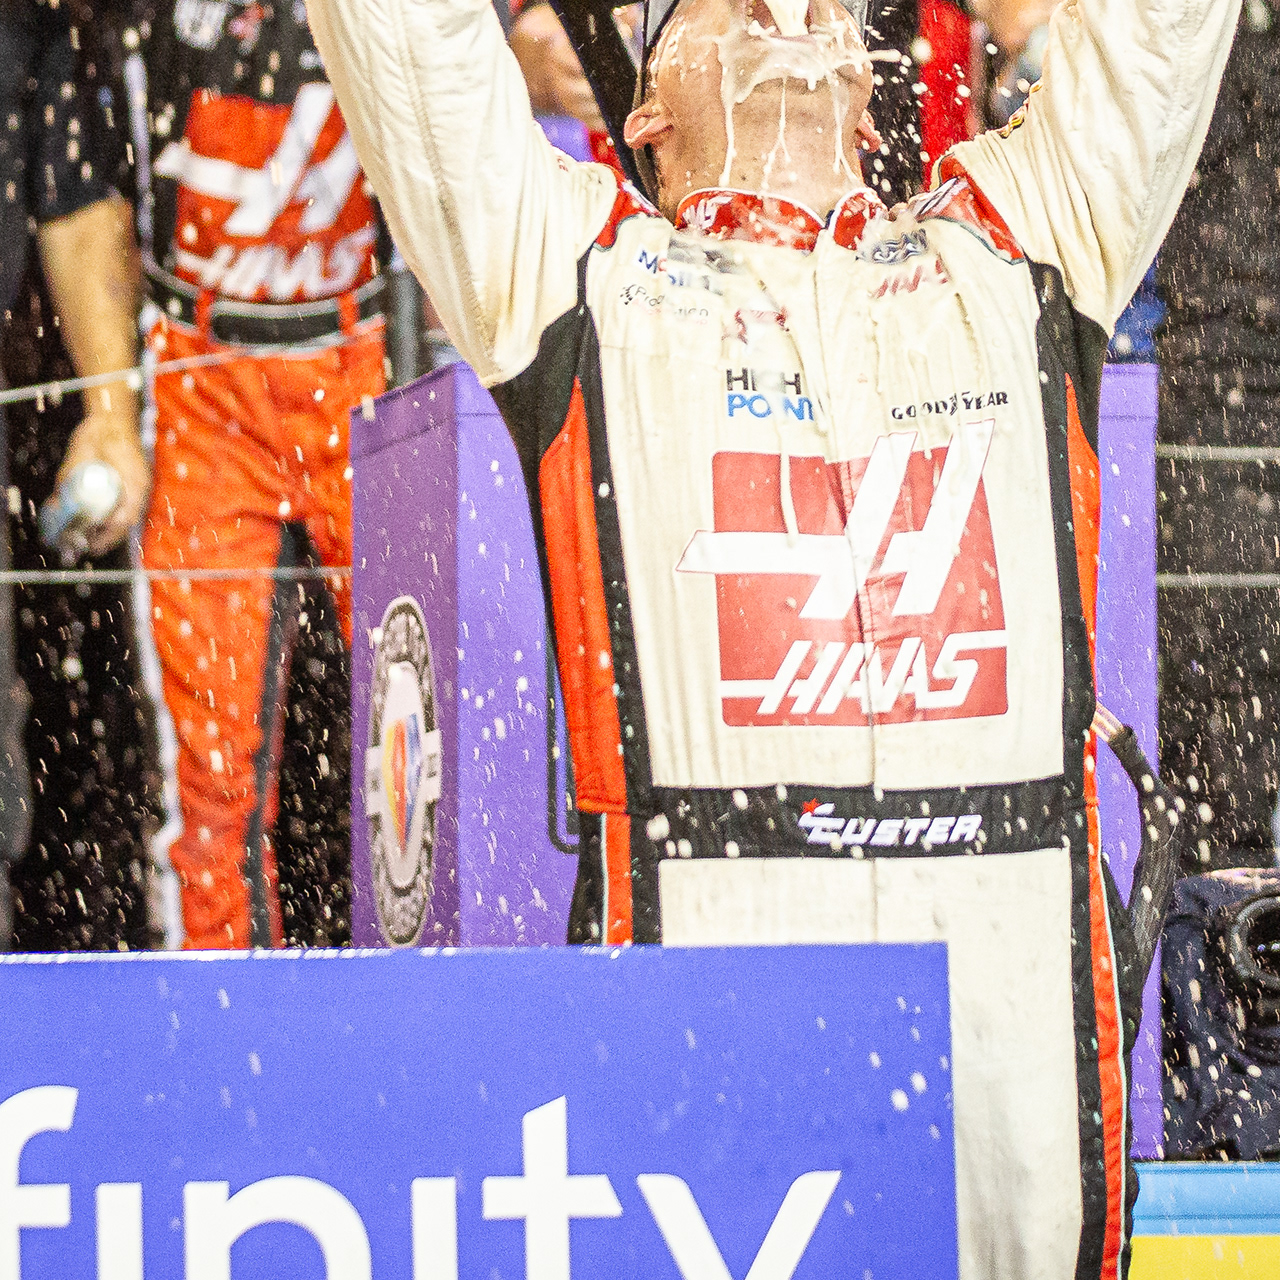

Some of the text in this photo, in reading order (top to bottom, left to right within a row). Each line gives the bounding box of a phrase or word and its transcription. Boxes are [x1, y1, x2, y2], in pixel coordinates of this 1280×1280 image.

[726, 367, 803, 396] HIH
[727, 393, 816, 422] PONT
[891, 390, 1010, 421] GOODYEAR
[720, 629, 1008, 716] HAAS
[797, 802, 983, 847] CUSTER
